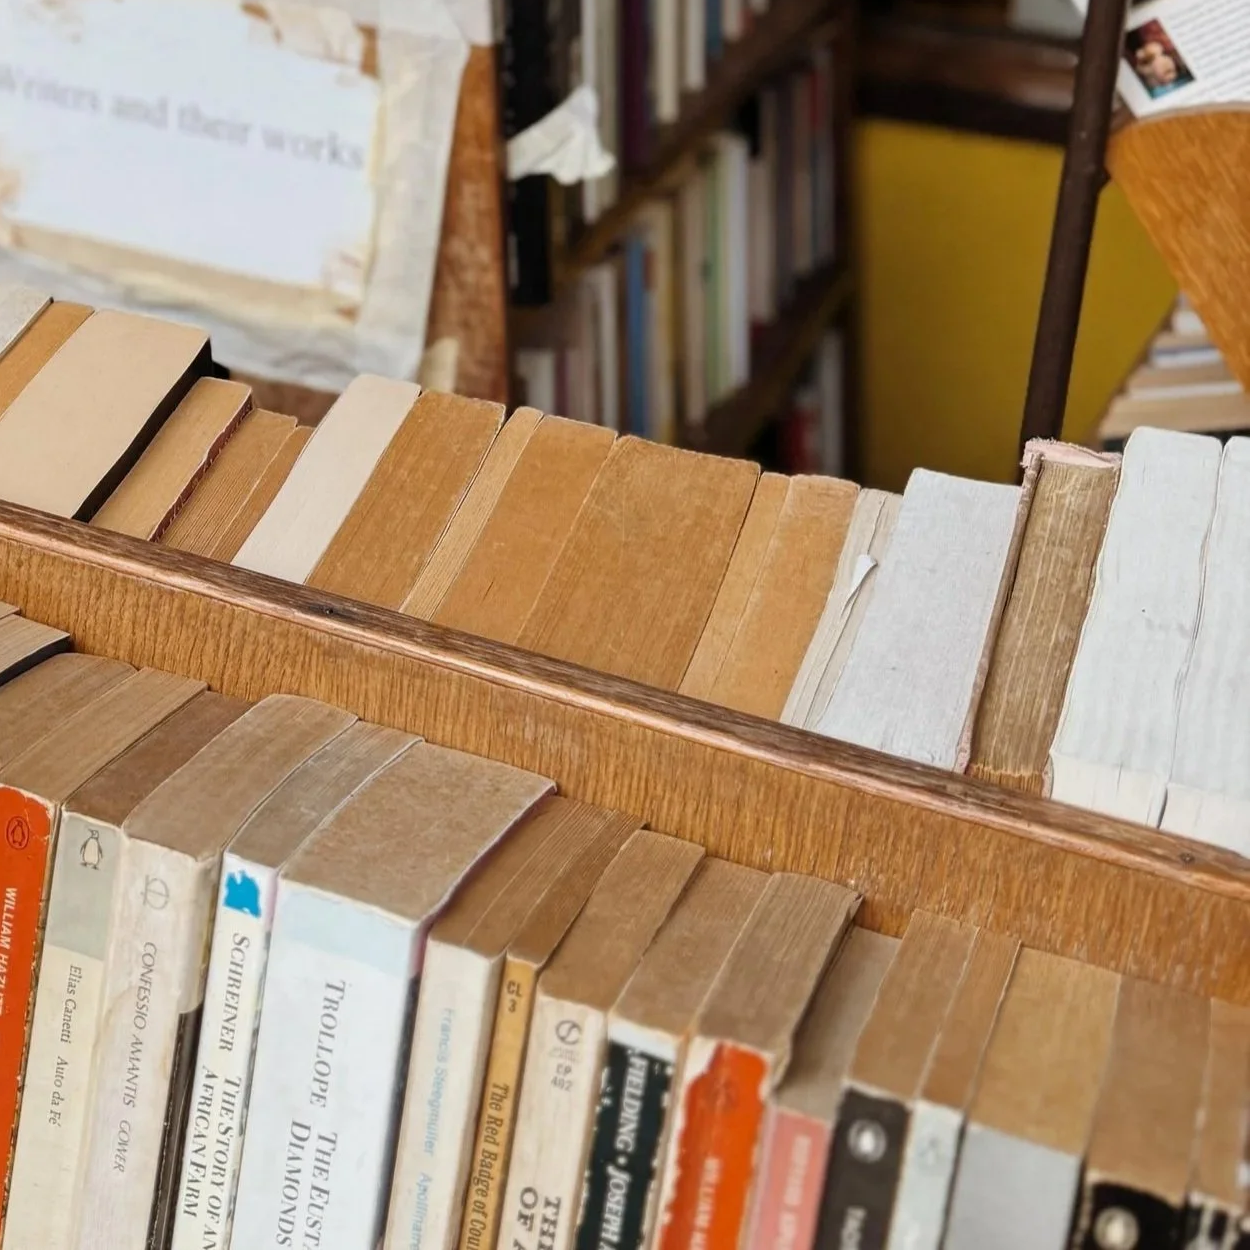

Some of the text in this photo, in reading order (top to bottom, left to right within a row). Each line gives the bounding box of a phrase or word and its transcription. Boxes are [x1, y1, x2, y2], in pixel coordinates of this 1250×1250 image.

[109, 93, 168, 130] and
[177, 102, 250, 147] their
[261, 126, 362, 171] works
[48, 964, 83, 1127] Elias Canetti Auto Fé
[436, 1007, 455, 1063] Francis
[506, 980, 523, 998] CL
[112, 941, 158, 1173] CONFESSIO AMANTIS GOWER
[209, 931, 251, 1195] SCHREINER THE STORY
[310, 979, 346, 1182] TROLLOPE THE
[183, 1064, 219, 1218] AFRICAN FARM
[275, 1119, 312, 1248] DIAMONDS
[473, 1083, 510, 1198] The Red Badge
[601, 1165, 632, 1243] JOSEPH
